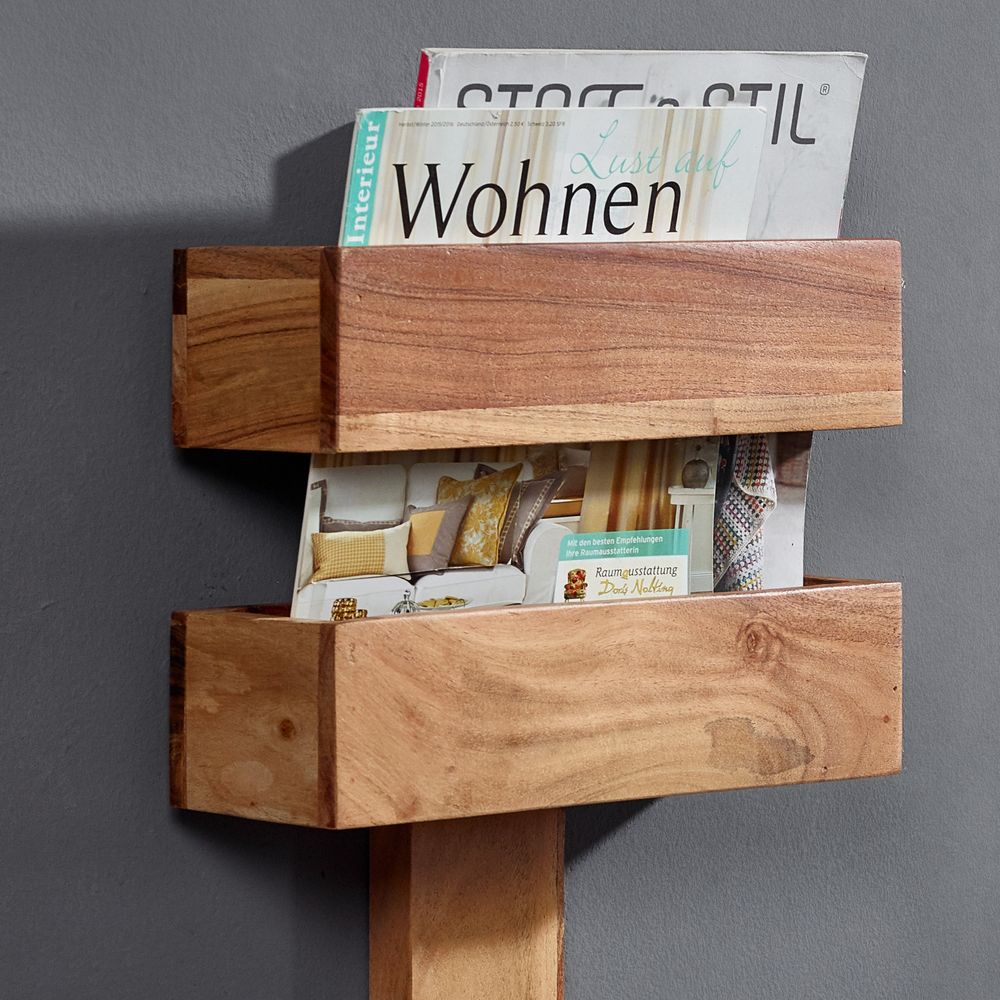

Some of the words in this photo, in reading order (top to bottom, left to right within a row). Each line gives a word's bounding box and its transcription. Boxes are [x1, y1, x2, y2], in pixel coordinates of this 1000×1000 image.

[570, 120, 660, 179] Lust
[674, 129, 741, 190] auf
[346, 121, 380, 244] Interieur
[392, 159, 681, 239] Wohnen
[568, 539, 577, 547] Mit
[579, 538, 591, 546] den
[592, 537, 614, 546] besten
[616, 535, 663, 545] Empfehlungen
[580, 546, 639, 556] Raumausstatterin
[595, 565, 678, 580] Raumausstattung
[598, 578, 628, 596] Doris
